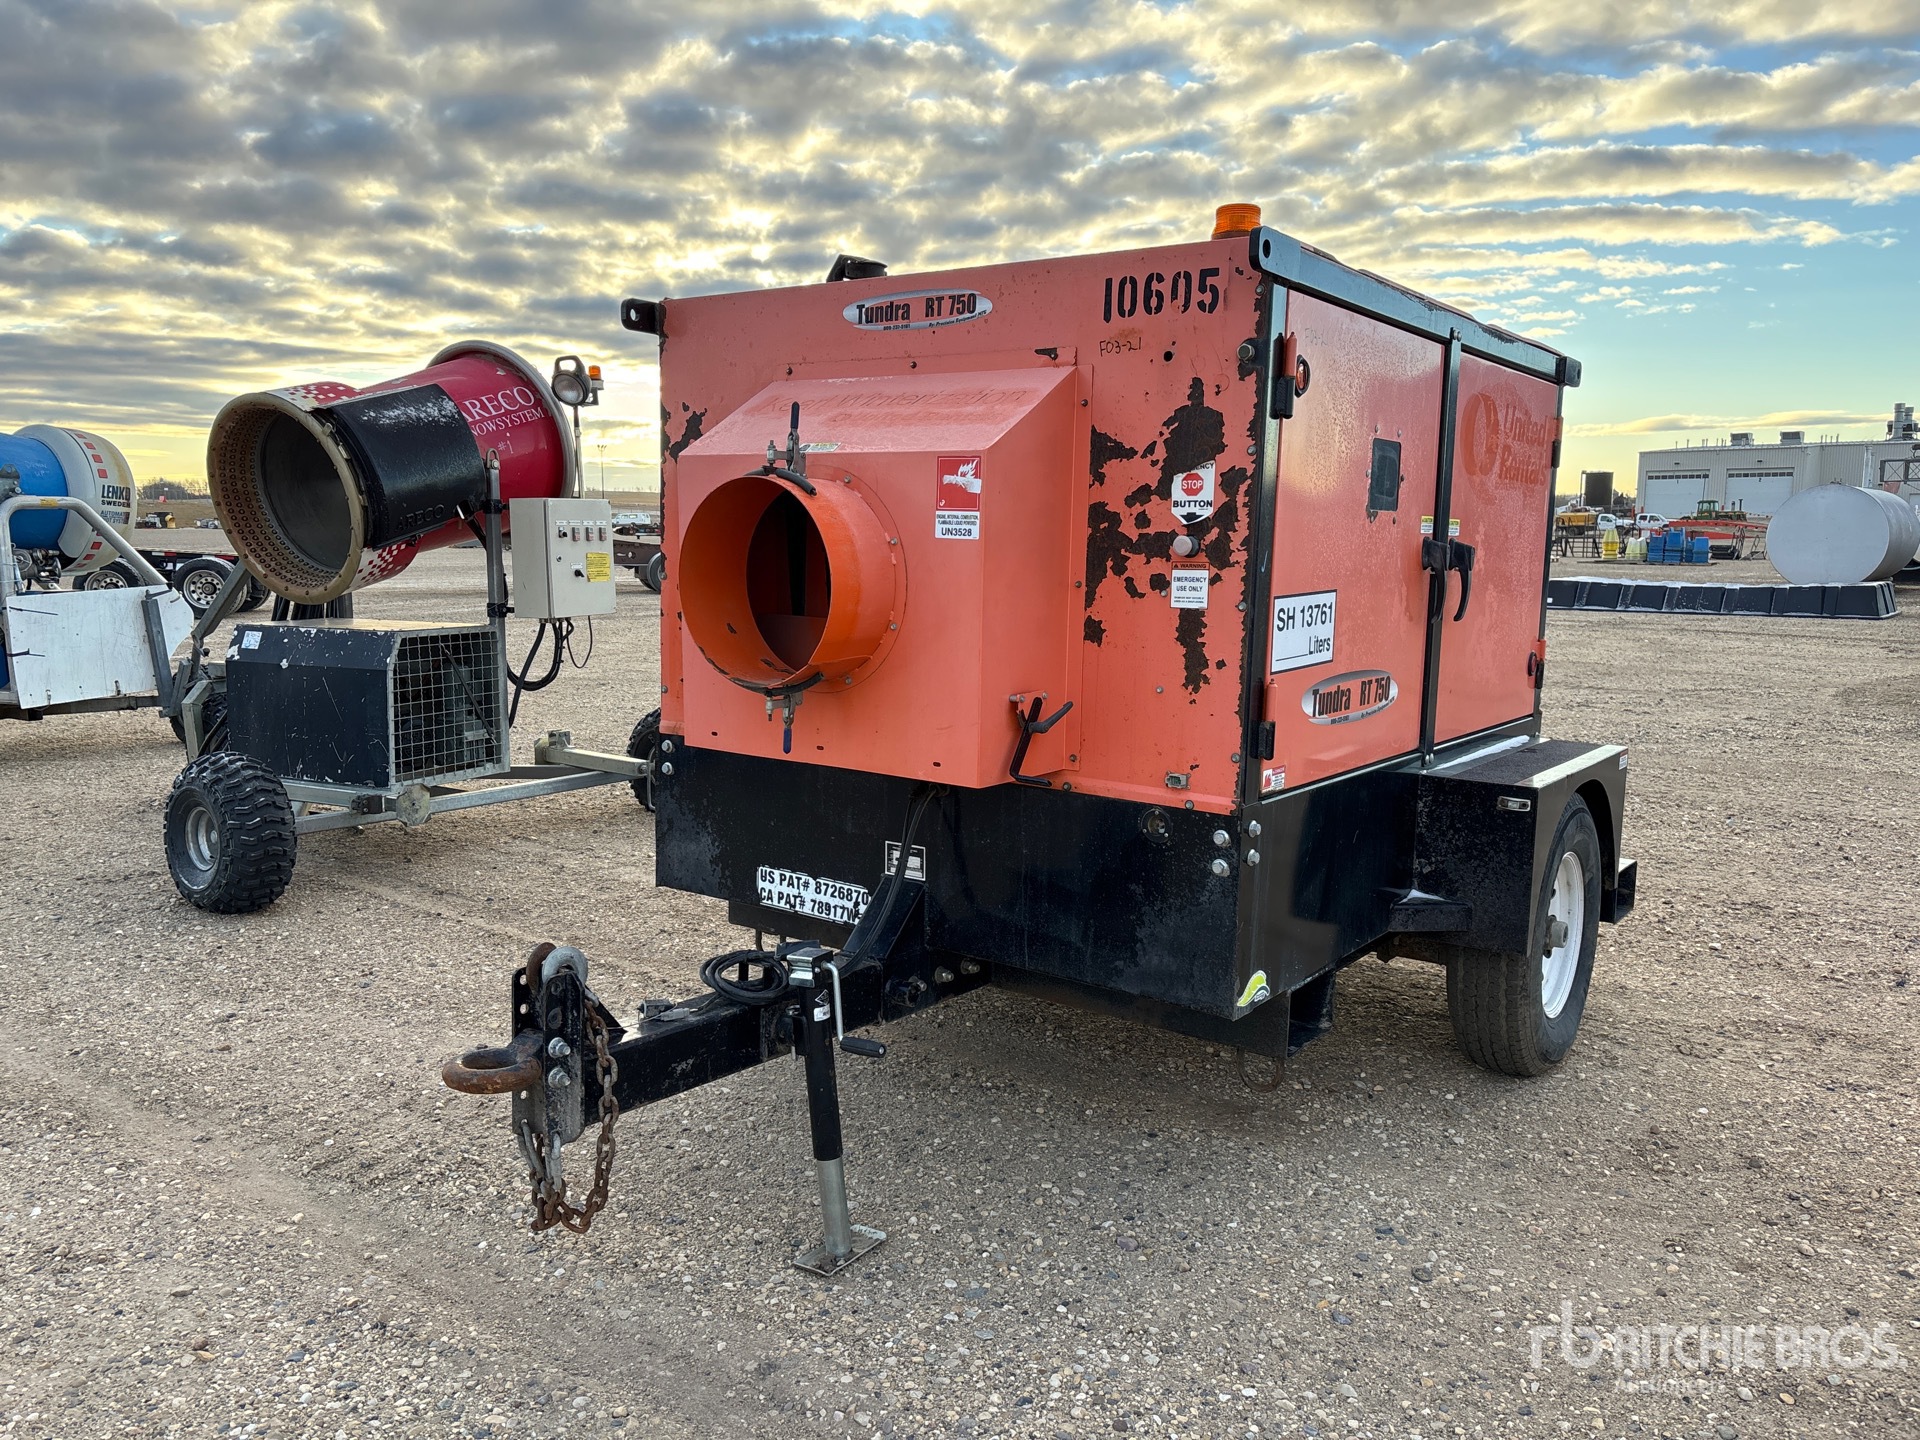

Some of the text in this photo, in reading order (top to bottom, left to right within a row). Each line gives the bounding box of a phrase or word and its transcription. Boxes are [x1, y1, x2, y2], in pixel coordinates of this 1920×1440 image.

[1103, 267, 1220, 323] 10605
[856, 293, 977, 325] Tundra RT 750
[1099, 337, 1141, 357] F03-21
[1182, 480, 1203, 490] STOP
[1172, 499, 1213, 508] BUTTON
[941, 527, 972, 537] UN3528
[1276, 602, 1333, 632] SH 13761
[1308, 635, 1331, 655] Liters
[1312, 685, 1351, 717] Tundra
[1360, 679, 1373, 706] RT
[1374, 676, 1391, 703] 750
[760, 868, 869, 906] US PAT# 8726870
[760, 887, 773, 903] CA
[777, 891, 806, 910] PAT#
